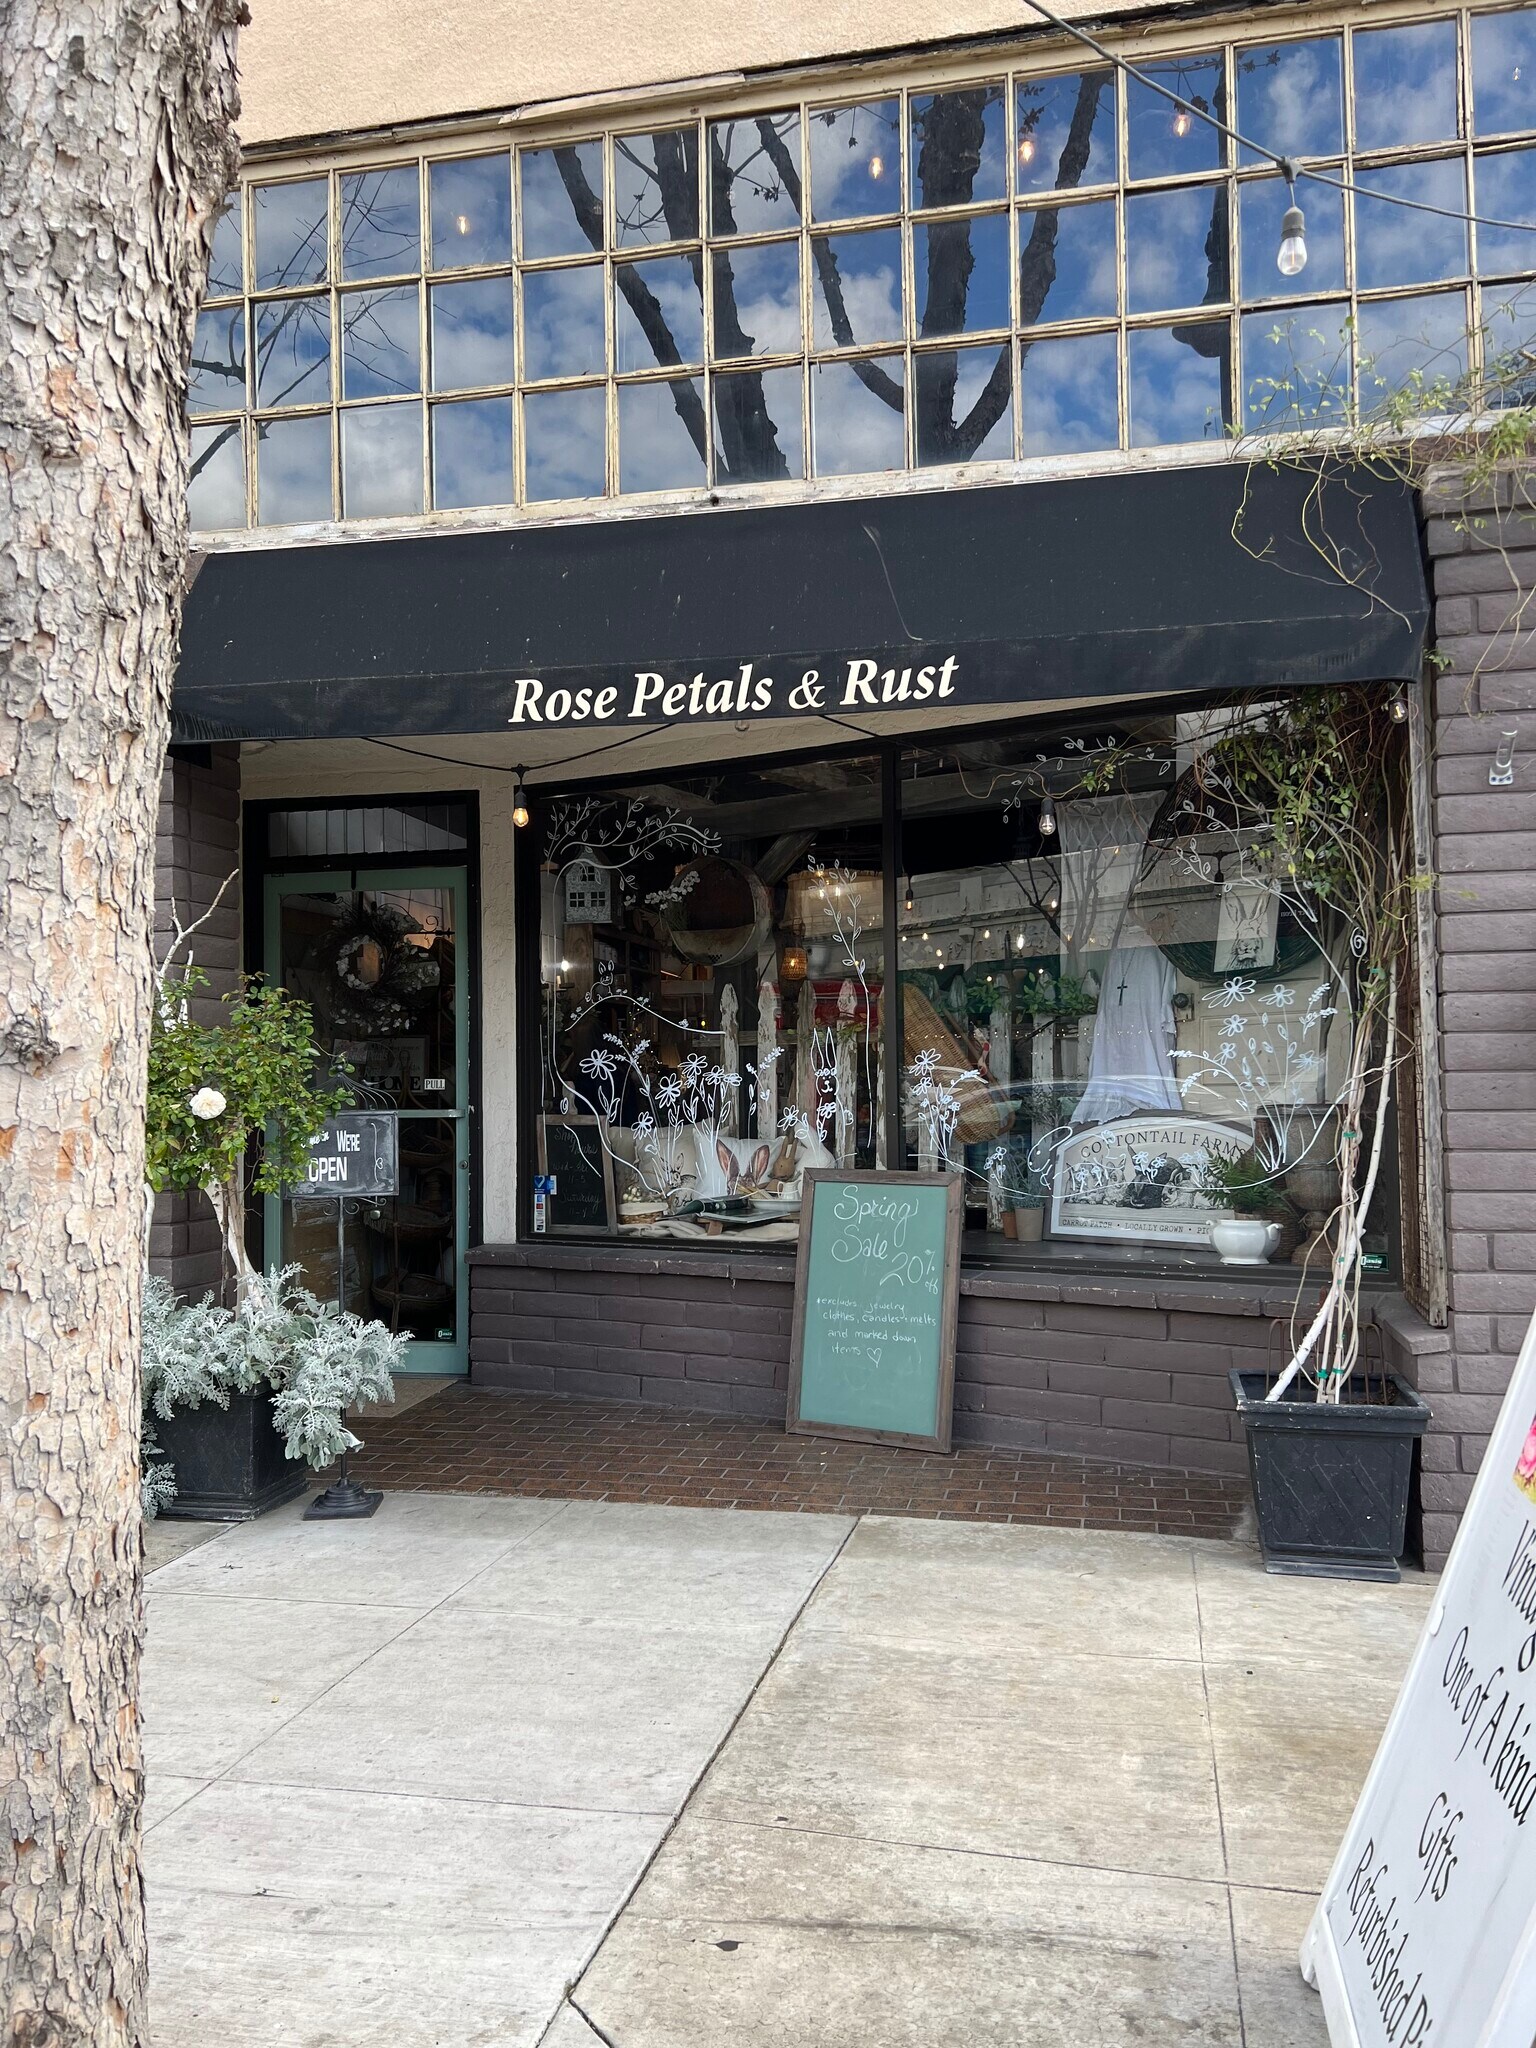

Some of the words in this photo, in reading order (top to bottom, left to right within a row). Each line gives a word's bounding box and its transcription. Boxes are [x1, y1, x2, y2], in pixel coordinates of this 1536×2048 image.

[508, 678, 618, 724] Rose
[627, 663, 774, 718] Petals
[788, 669, 826, 710] &
[839, 654, 960, 706] Rust
[425, 1080, 445, 1089] PULL
[308, 1157, 348, 1182] OPEN
[833, 1185, 919, 1248] Spring
[1125, 1222, 1158, 1232] LOCALLY
[1159, 1224, 1184, 1233] GROWN
[831, 1224, 888, 1262] Sale
[880, 1249, 937, 1287] 20%
[827, 1328, 848, 1339] and
[854, 1330, 888, 1341] marked
[892, 1331, 917, 1343] down
[832, 1341, 861, 1355] items
[1443, 1626, 1474, 1711] One
[1454, 1666, 1504, 1761] of
[1474, 1690, 1509, 1766] A
[1414, 1791, 1464, 1904] Gifts
[1343, 1837, 1423, 2044] Refurbished
